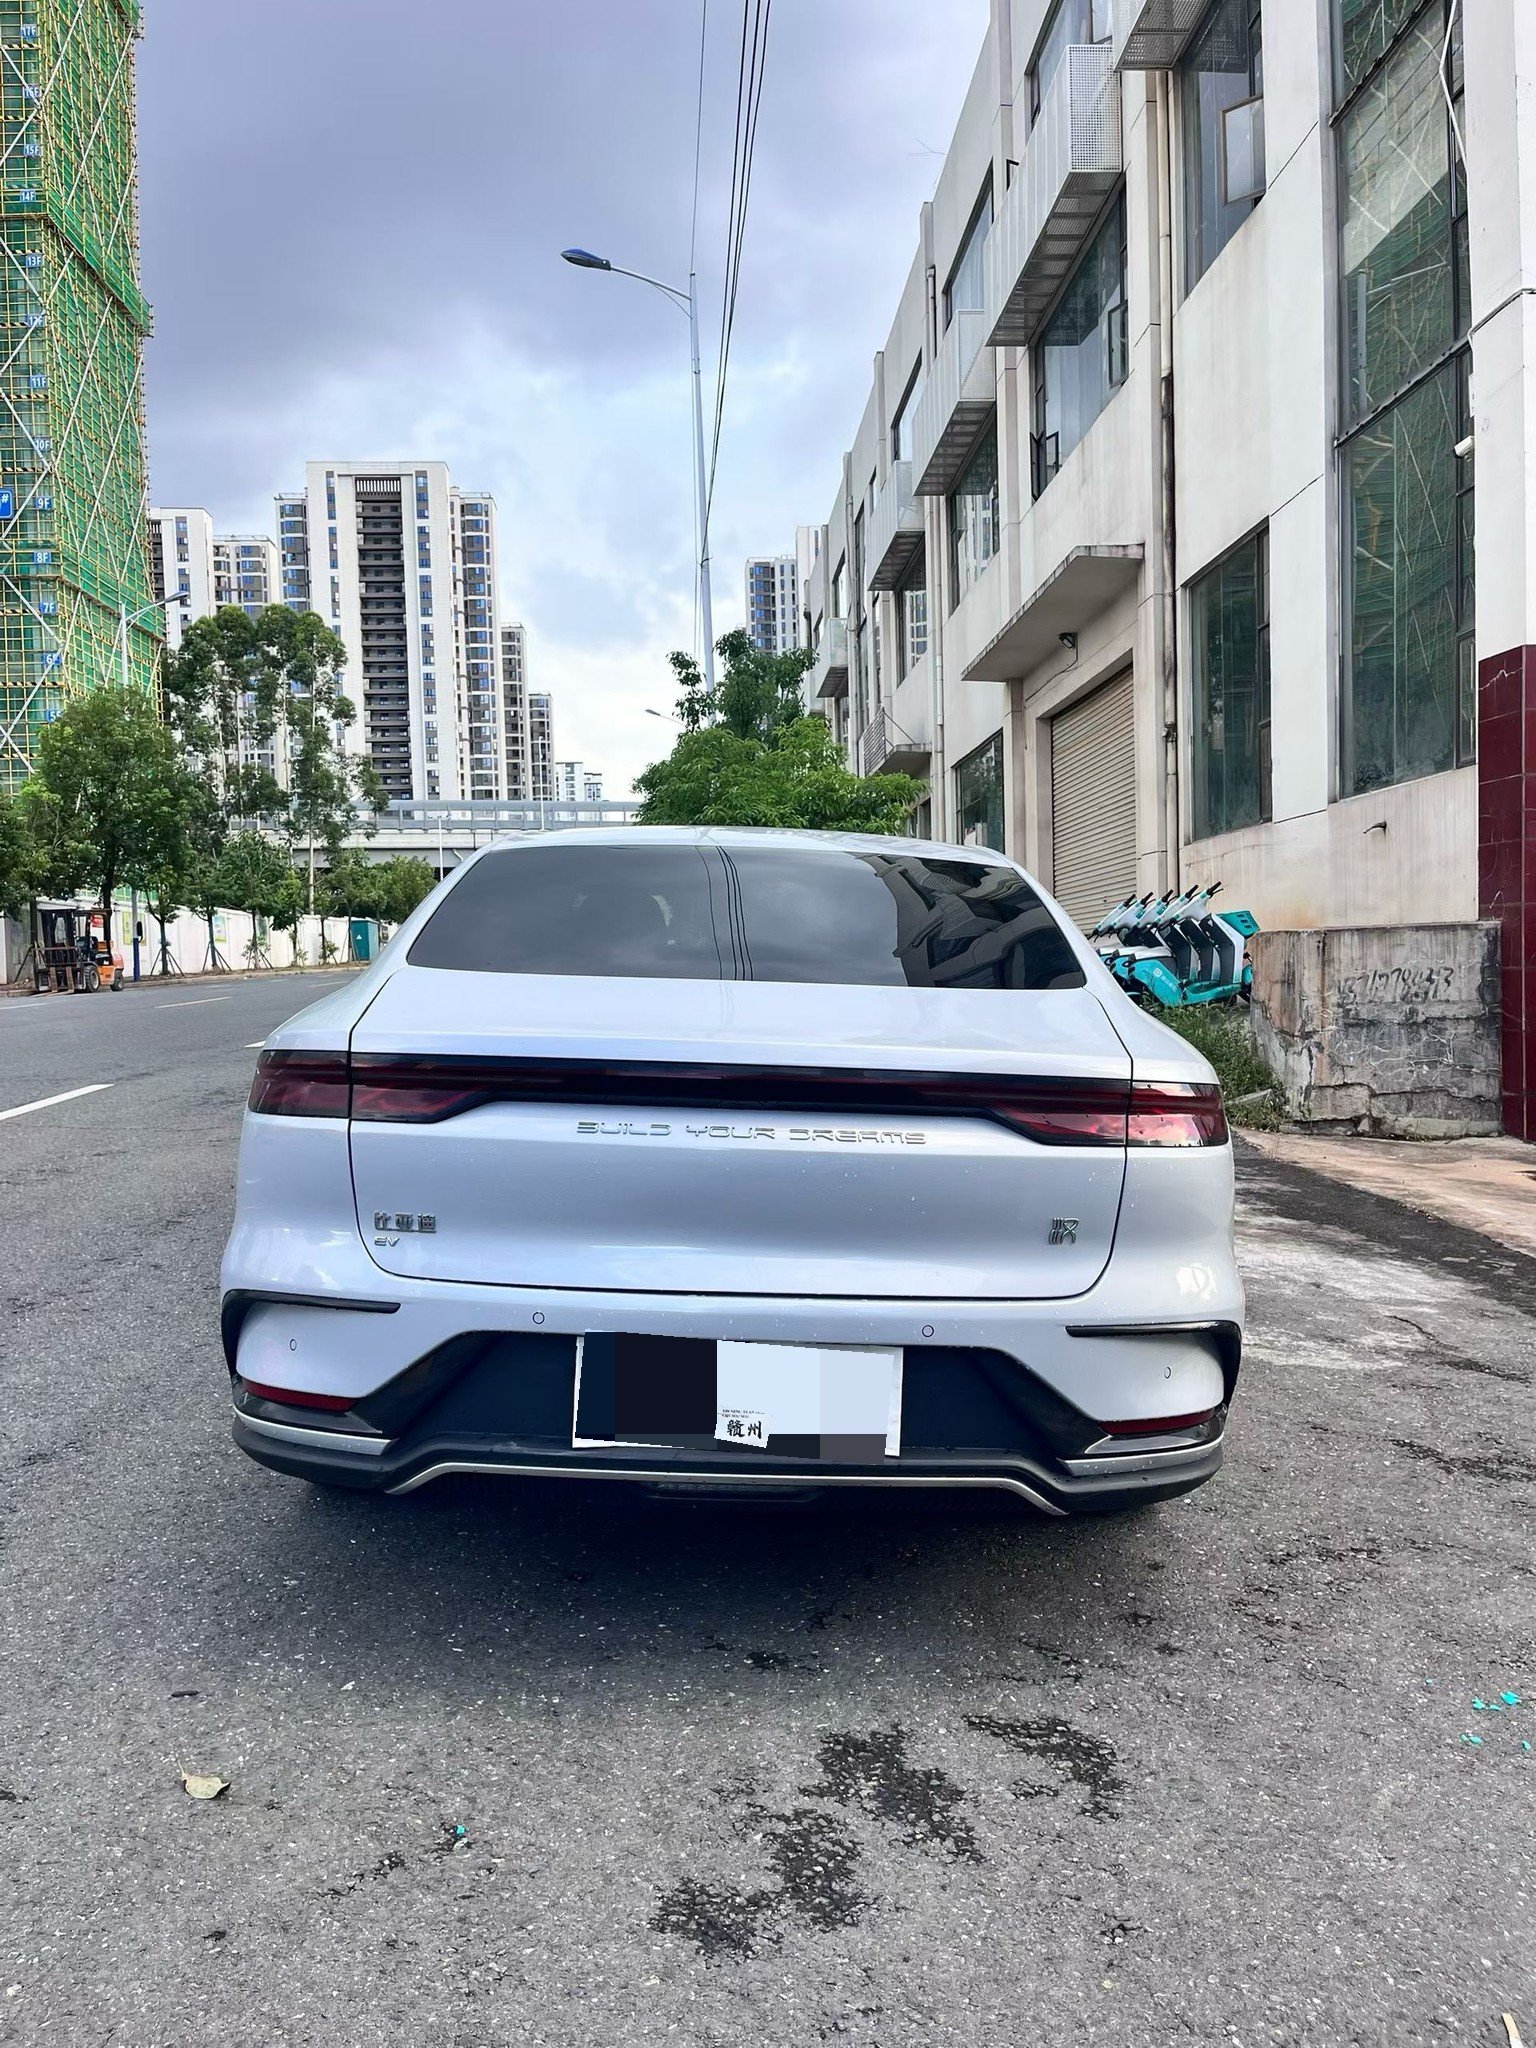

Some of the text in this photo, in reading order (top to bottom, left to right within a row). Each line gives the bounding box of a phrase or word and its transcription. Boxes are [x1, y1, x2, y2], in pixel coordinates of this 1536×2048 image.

[22, 27, 36, 37] 17F
[25, 145, 39, 154] 15F
[22, 191, 35, 200] 14F
[28, 256, 41, 265] 13F
[33, 378, 47, 387] 11F
[36, 440, 50, 449] 10F
[38, 499, 50, 508] 9F
[37, 553, 49, 563] 8F
[44, 602, 55, 612] 7F
[576, 1120, 927, 1145] BUILD YOUR DREAMS
[374, 1210, 437, 1234] 比亚迪
[374, 1236, 401, 1248] EV
[726, 1419, 762, 1440] 赣州
